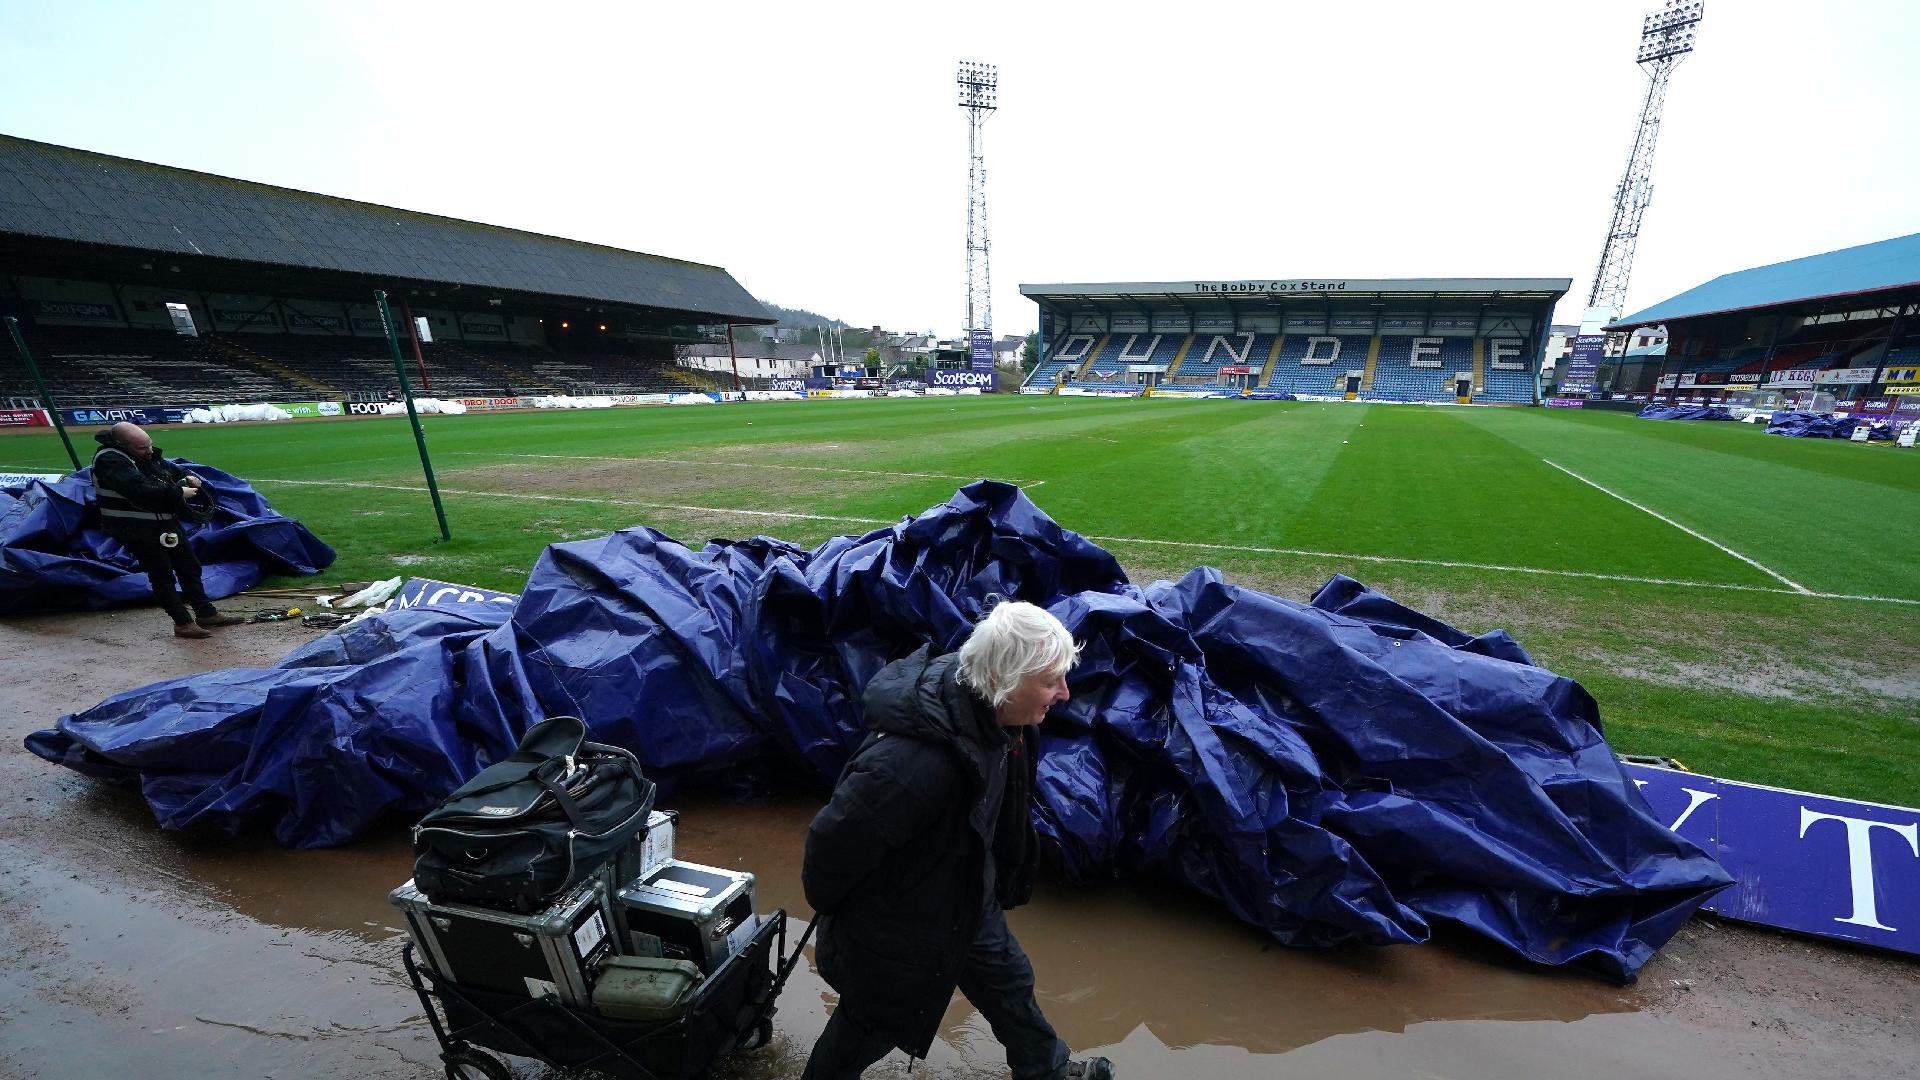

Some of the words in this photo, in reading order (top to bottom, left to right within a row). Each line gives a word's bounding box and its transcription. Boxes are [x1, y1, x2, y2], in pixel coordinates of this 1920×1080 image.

[1195, 283, 1217, 292] The
[1221, 282, 1265, 292] Bobby
[1270, 282, 1297, 291] Cox
[1301, 281, 1346, 291] Stand
